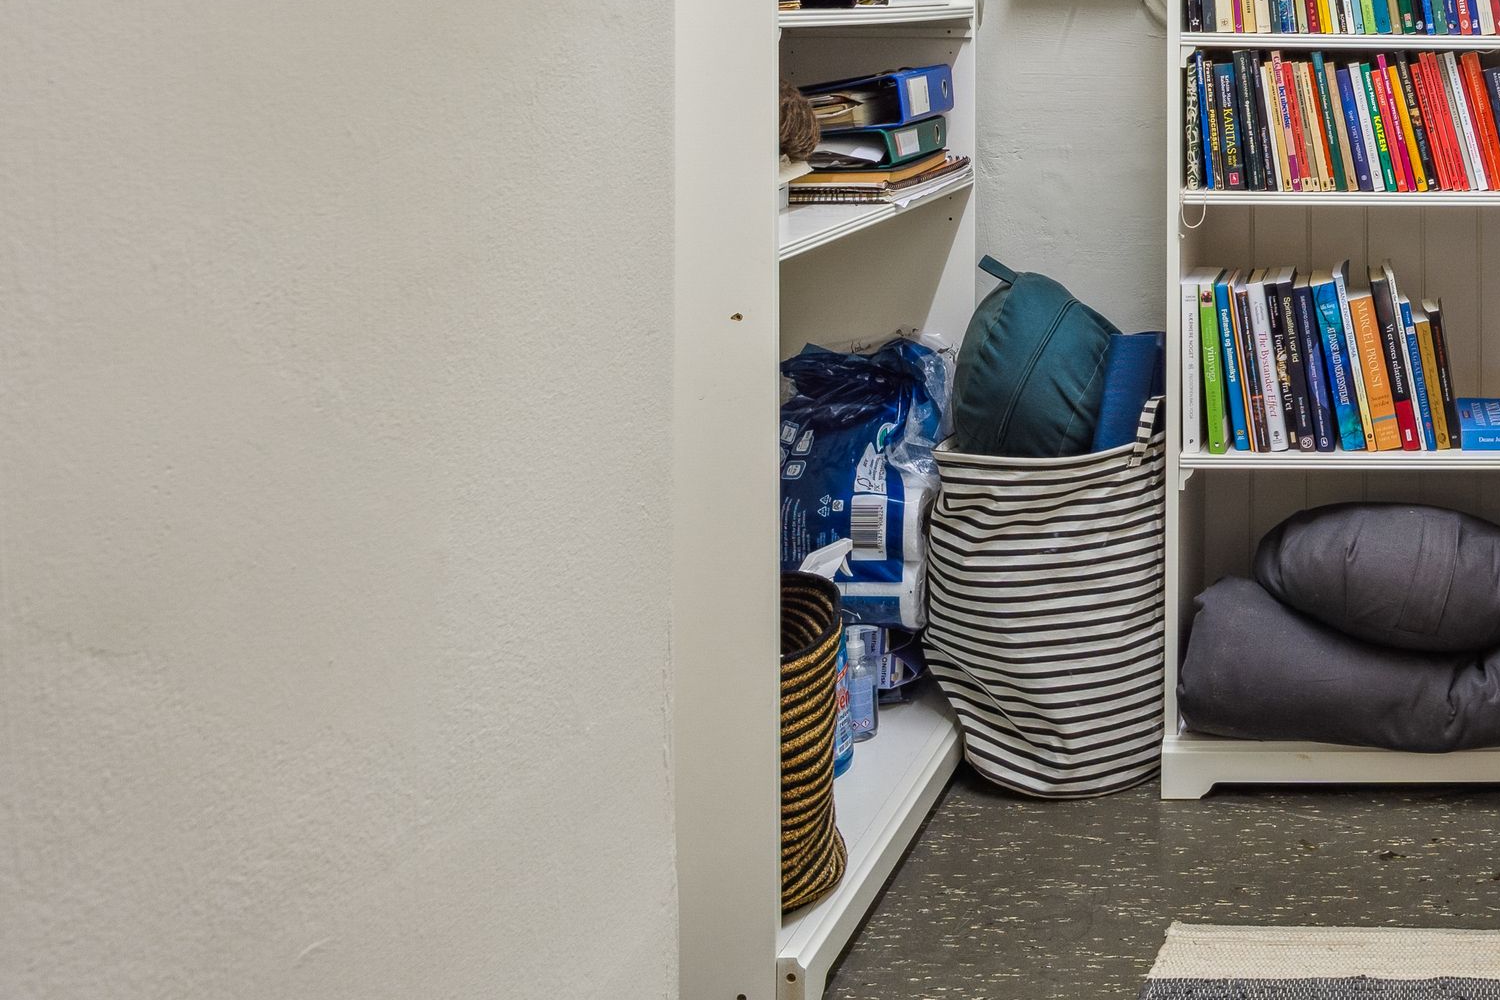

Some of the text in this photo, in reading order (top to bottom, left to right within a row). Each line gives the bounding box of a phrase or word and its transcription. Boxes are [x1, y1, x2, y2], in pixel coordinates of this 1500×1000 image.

[1209, 109, 1218, 152] PROCESSEN
[1223, 109, 1237, 154] KARITAS
[1365, 71, 1387, 152] Robert Maurer KAIZEN
[1283, 296, 1295, 337] Spiritualitet
[1338, 284, 1357, 358] TRANSCENDING TRAUMA
[1386, 323, 1394, 333] Vi
[1205, 346, 1217, 383] yinyoga
[1221, 308, 1236, 383] Fodfæste og himmelkys
[1288, 341, 1296, 353] vor
[1291, 354, 1299, 363] tid
[1356, 300, 1382, 389] MARCEL PROUST
[1389, 341, 1398, 360] vores
[1257, 331, 1277, 418] The Bystander Effect
[1392, 360, 1404, 394] relationer
